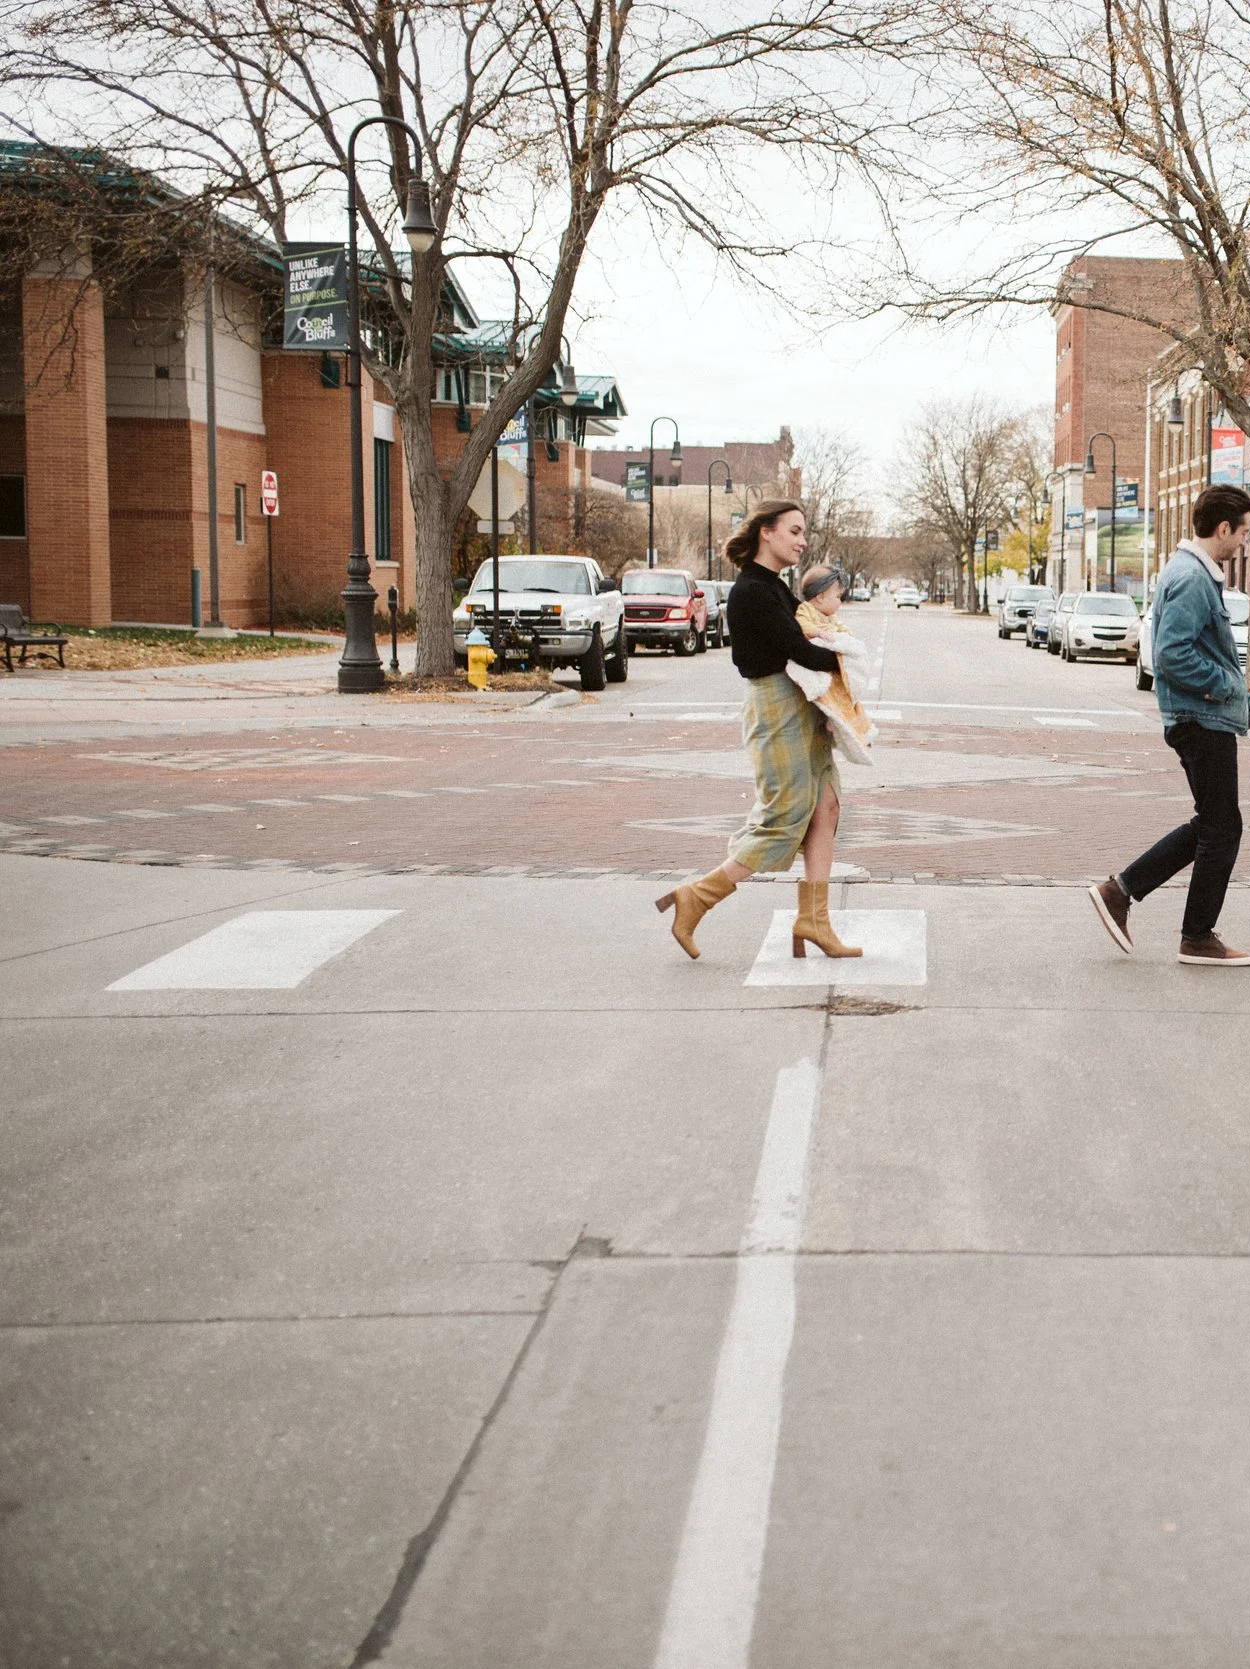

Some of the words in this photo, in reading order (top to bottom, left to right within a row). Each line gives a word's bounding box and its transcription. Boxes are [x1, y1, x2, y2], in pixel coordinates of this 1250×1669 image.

[289, 257, 318, 271] UNLIKE
[290, 265, 335, 281] ANYWHERE
[290, 280, 312, 292] ELSE.
[290, 293, 301, 304] ON
[302, 288, 338, 302] PURPOSE.
[297, 312, 333, 330] Council
[304, 325, 336, 341] Bluffs
